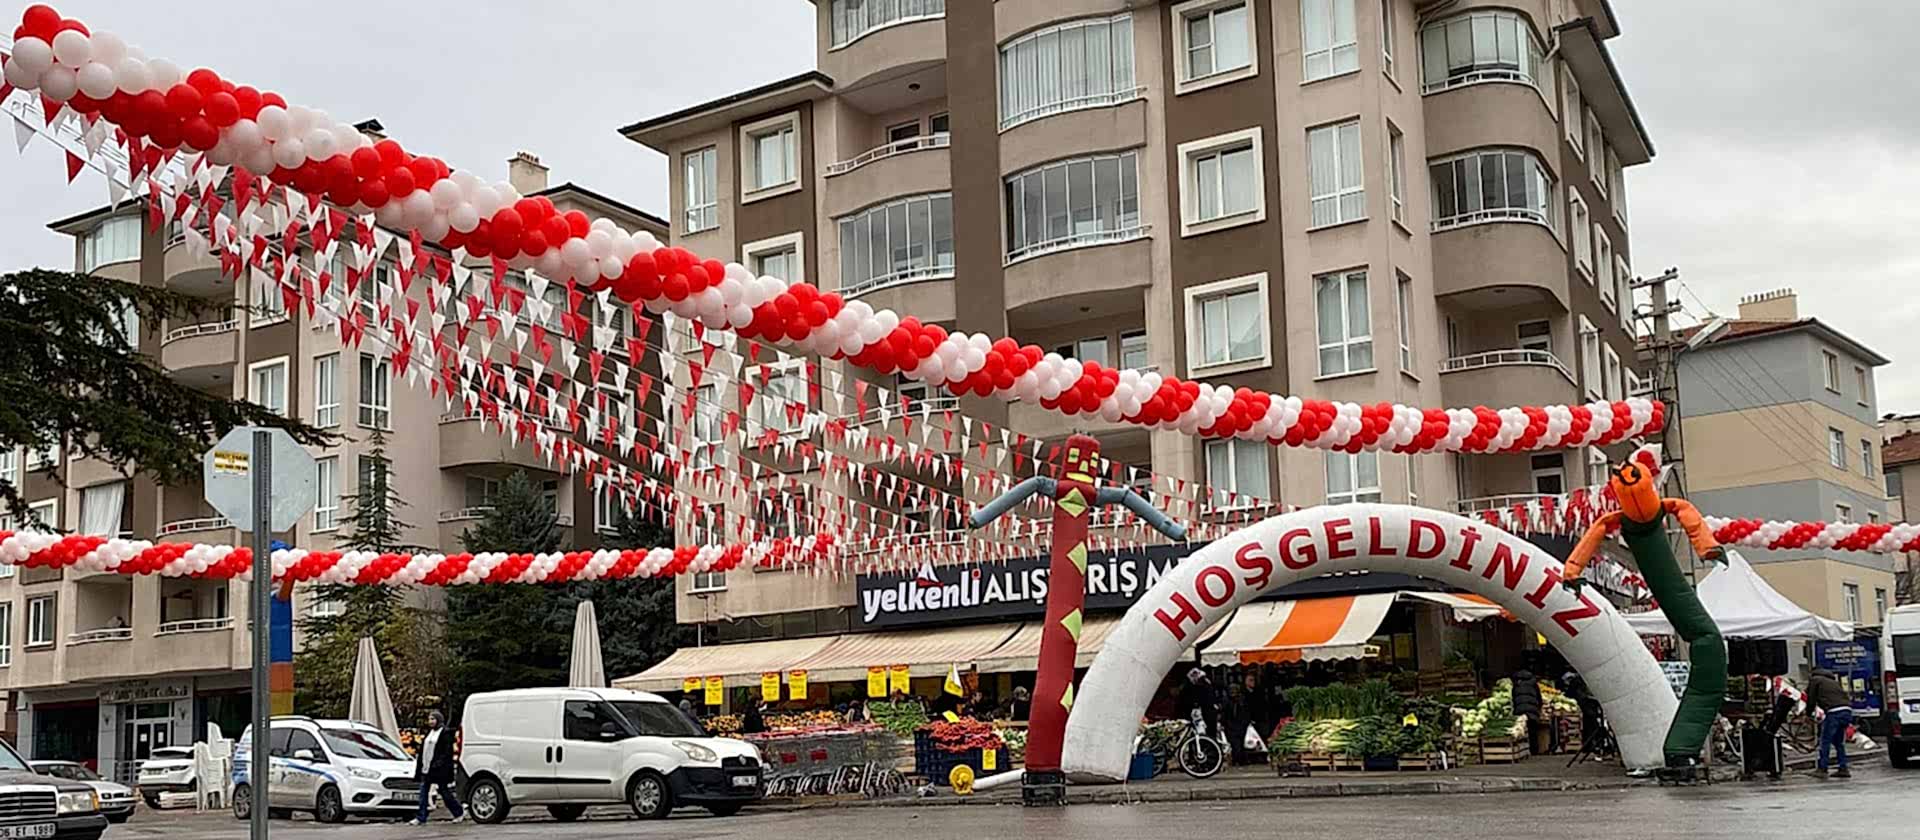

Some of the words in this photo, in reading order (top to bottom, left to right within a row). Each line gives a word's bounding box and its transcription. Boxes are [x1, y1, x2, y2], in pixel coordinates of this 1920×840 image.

[862, 569, 981, 622] yelkenli
[983, 558, 1138, 604] ALIŞRİŞ
[1153, 516, 1601, 641] HOŞGELDİNİZ
